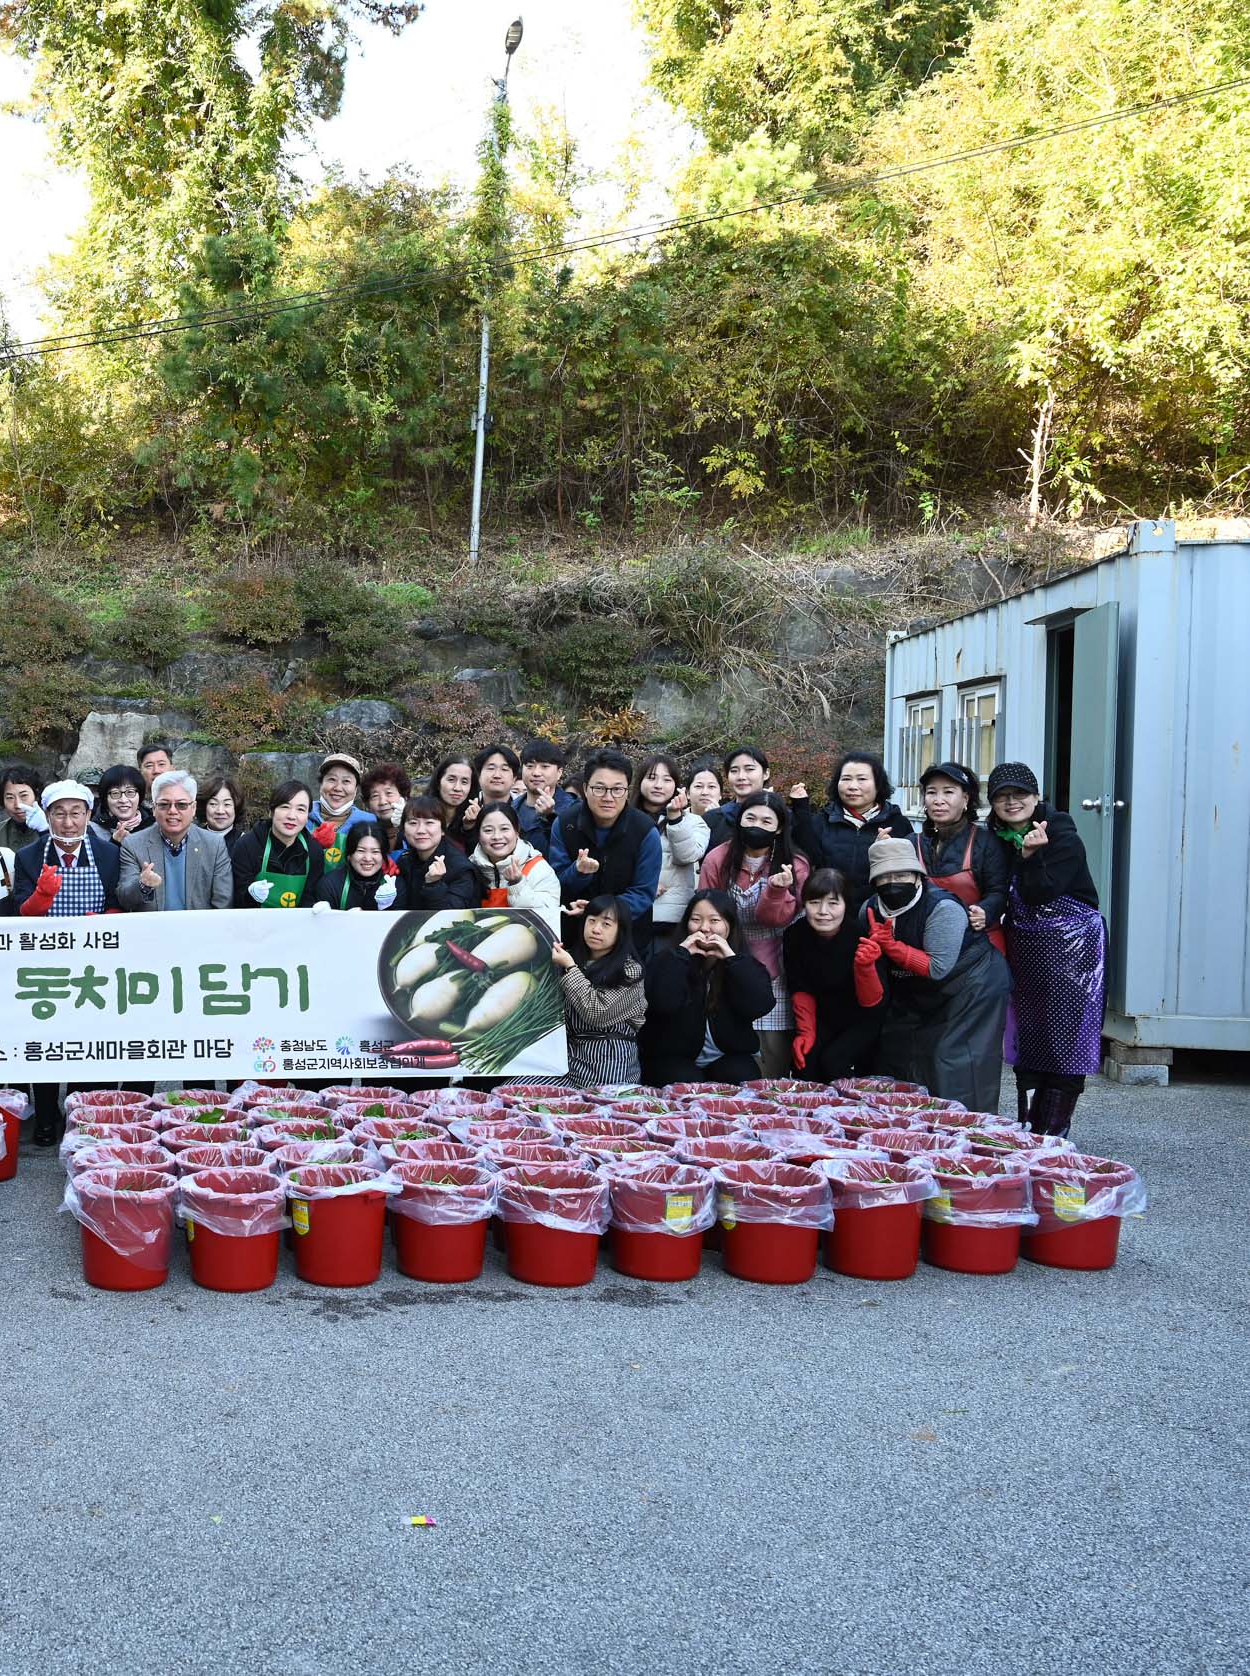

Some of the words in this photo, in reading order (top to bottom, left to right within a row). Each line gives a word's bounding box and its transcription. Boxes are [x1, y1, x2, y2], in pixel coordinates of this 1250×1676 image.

[18, 931, 77, 951] 활성화
[82, 930, 120, 950] 사업
[23, 1039, 188, 1062] 홍성군새마을회관
[193, 1038, 235, 1059] 마당
[280, 1039, 328, 1052] 충청남도
